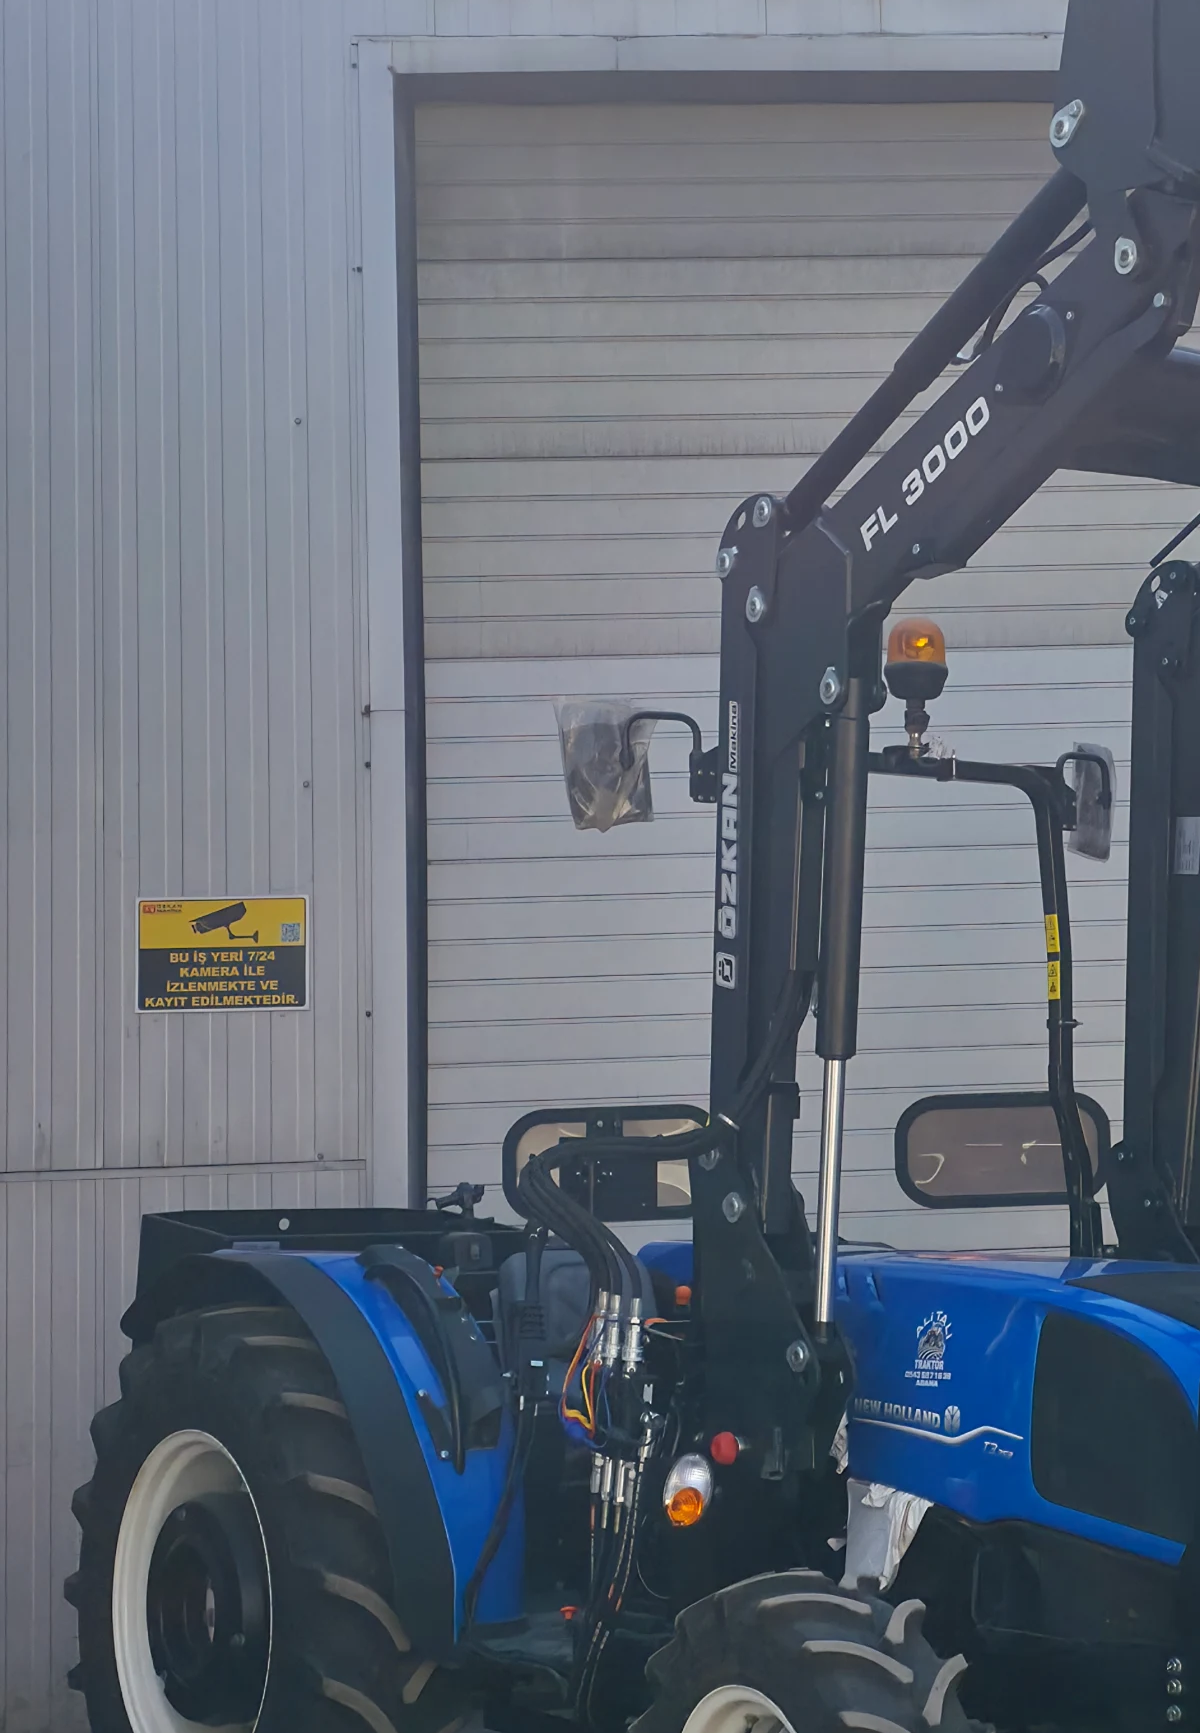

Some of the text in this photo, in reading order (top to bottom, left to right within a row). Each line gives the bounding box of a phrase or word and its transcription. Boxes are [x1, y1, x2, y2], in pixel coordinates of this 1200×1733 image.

[859, 396, 990, 552] FL 3000
[718, 772, 738, 939] ÖZKAN
[729, 701, 738, 772] Makina
[169, 950, 276, 965] BU İŞ YERİ 7/24
[179, 964, 265, 978] KAMERA İLE
[166, 980, 279, 993] İZLENMEKTE VE
[145, 993, 299, 1008] KAYIT EDİLMEKTEDİR.
[854, 1397, 941, 1429] NEW HOLLAND
